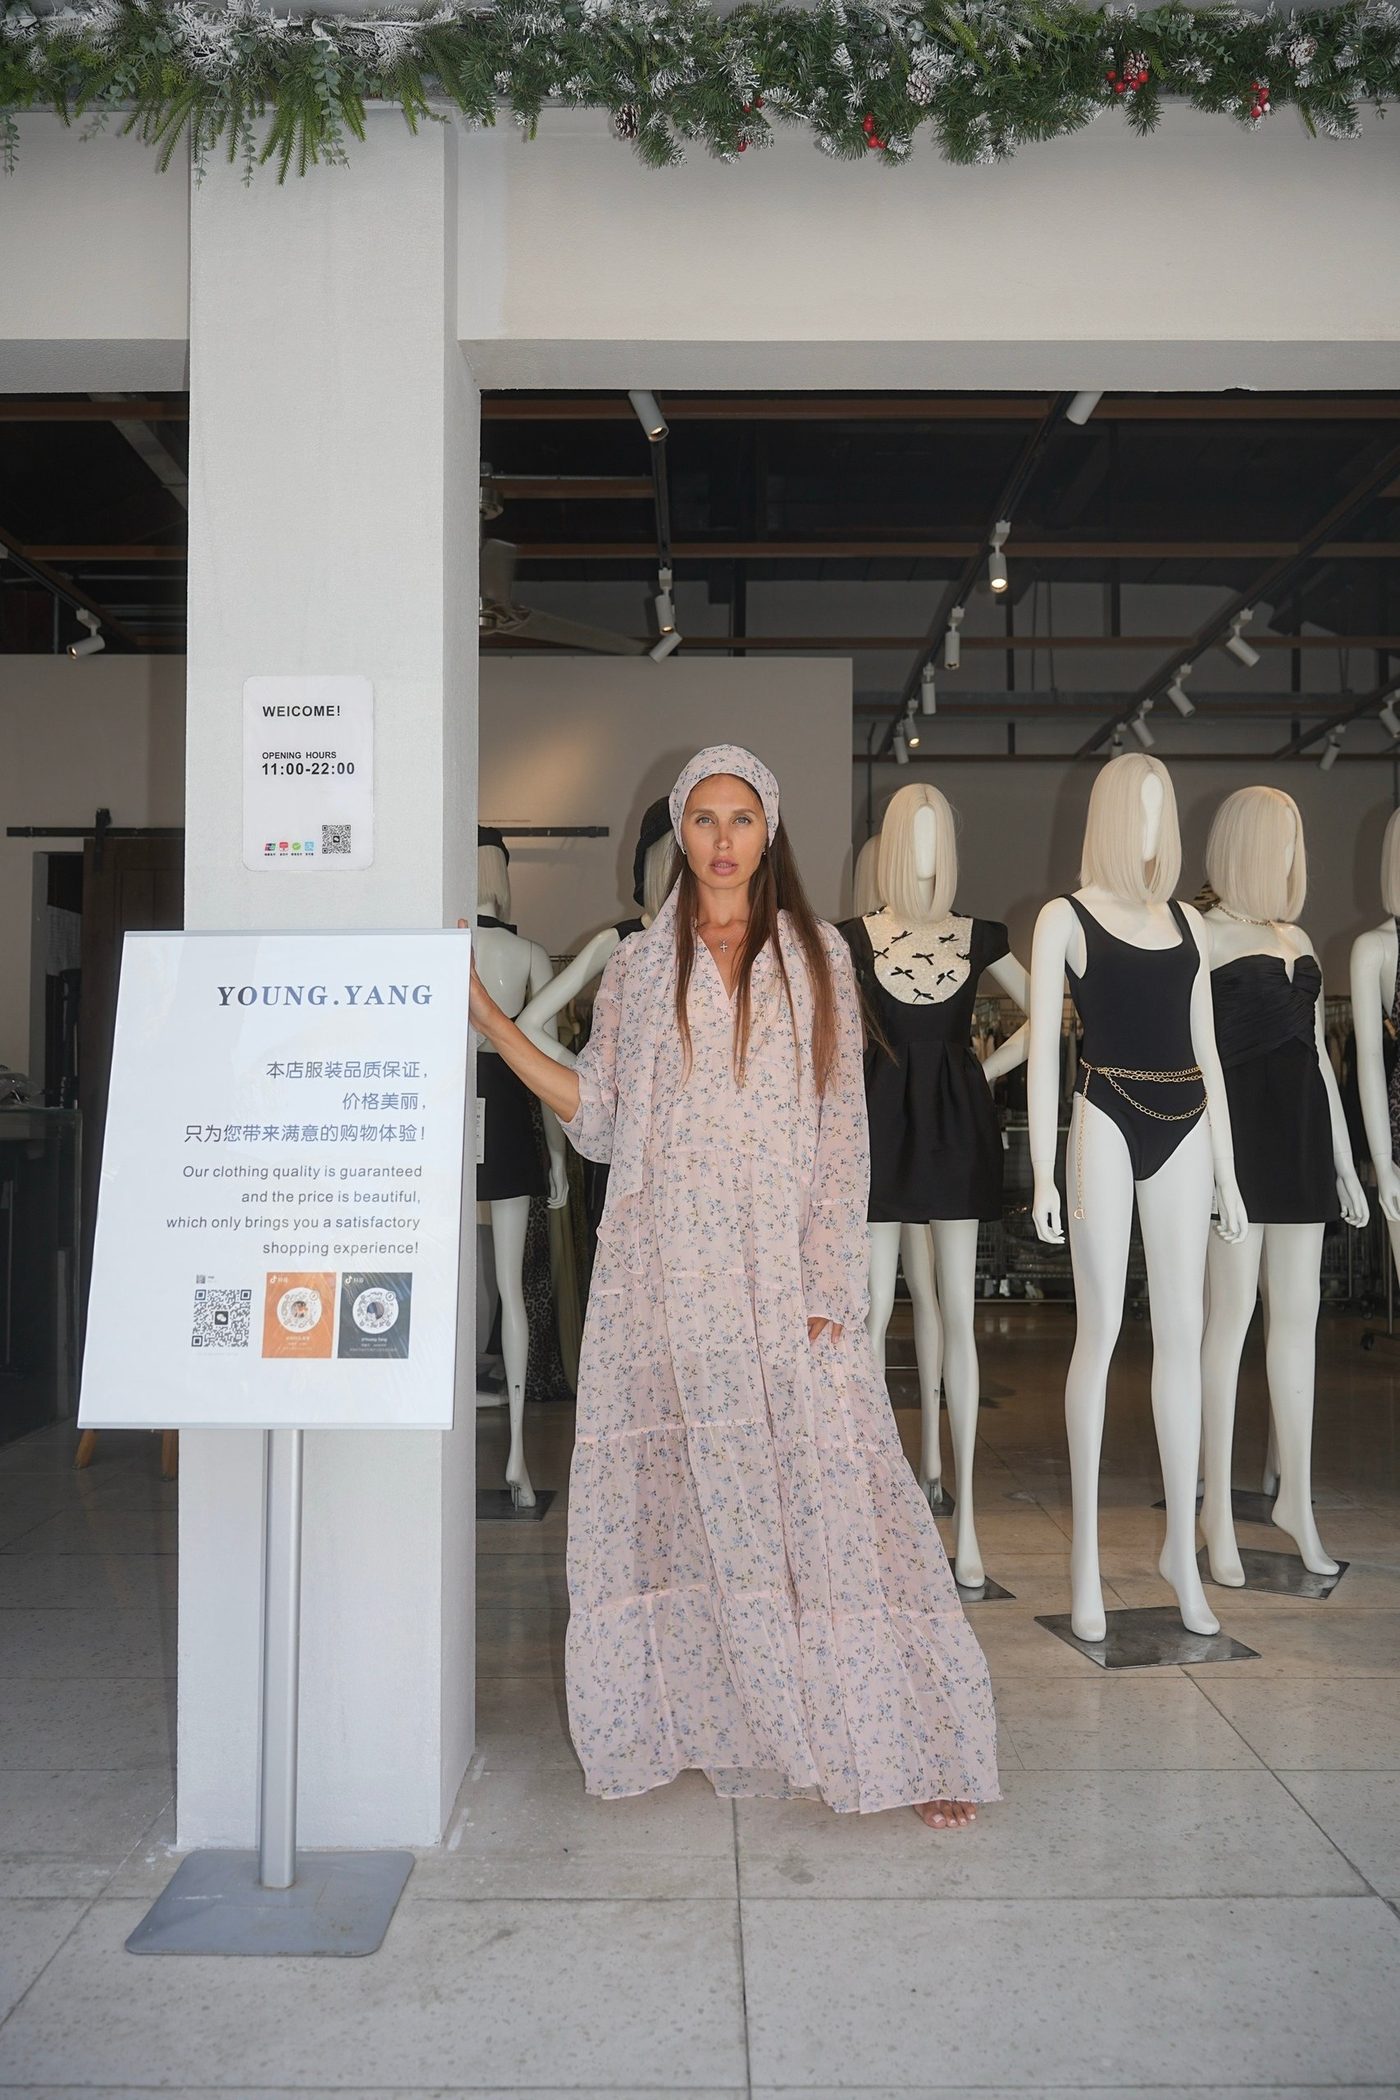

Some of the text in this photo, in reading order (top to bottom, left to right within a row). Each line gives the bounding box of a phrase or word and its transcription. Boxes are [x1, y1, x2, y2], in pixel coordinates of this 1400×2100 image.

[261, 704, 341, 718] WEICOME!
[261, 750, 337, 760] OPENING HOURS
[261, 761, 356, 776] 11:00-22:00
[216, 984, 433, 1007] YOUNG.YANG
[265, 1060, 428, 1080] 本店服装品质保证，
[341, 1091, 426, 1111] 价格美丽，
[183, 1123, 425, 1144] 只为您带来满意的购物体验！
[182, 1164, 423, 1181] Our clothing quality is guaranteed
[241, 1190, 421, 1206] and the price is beautiful,
[166, 1215, 421, 1232] which only brings you a satisfactory
[262, 1241, 419, 1257] shopping experience!
